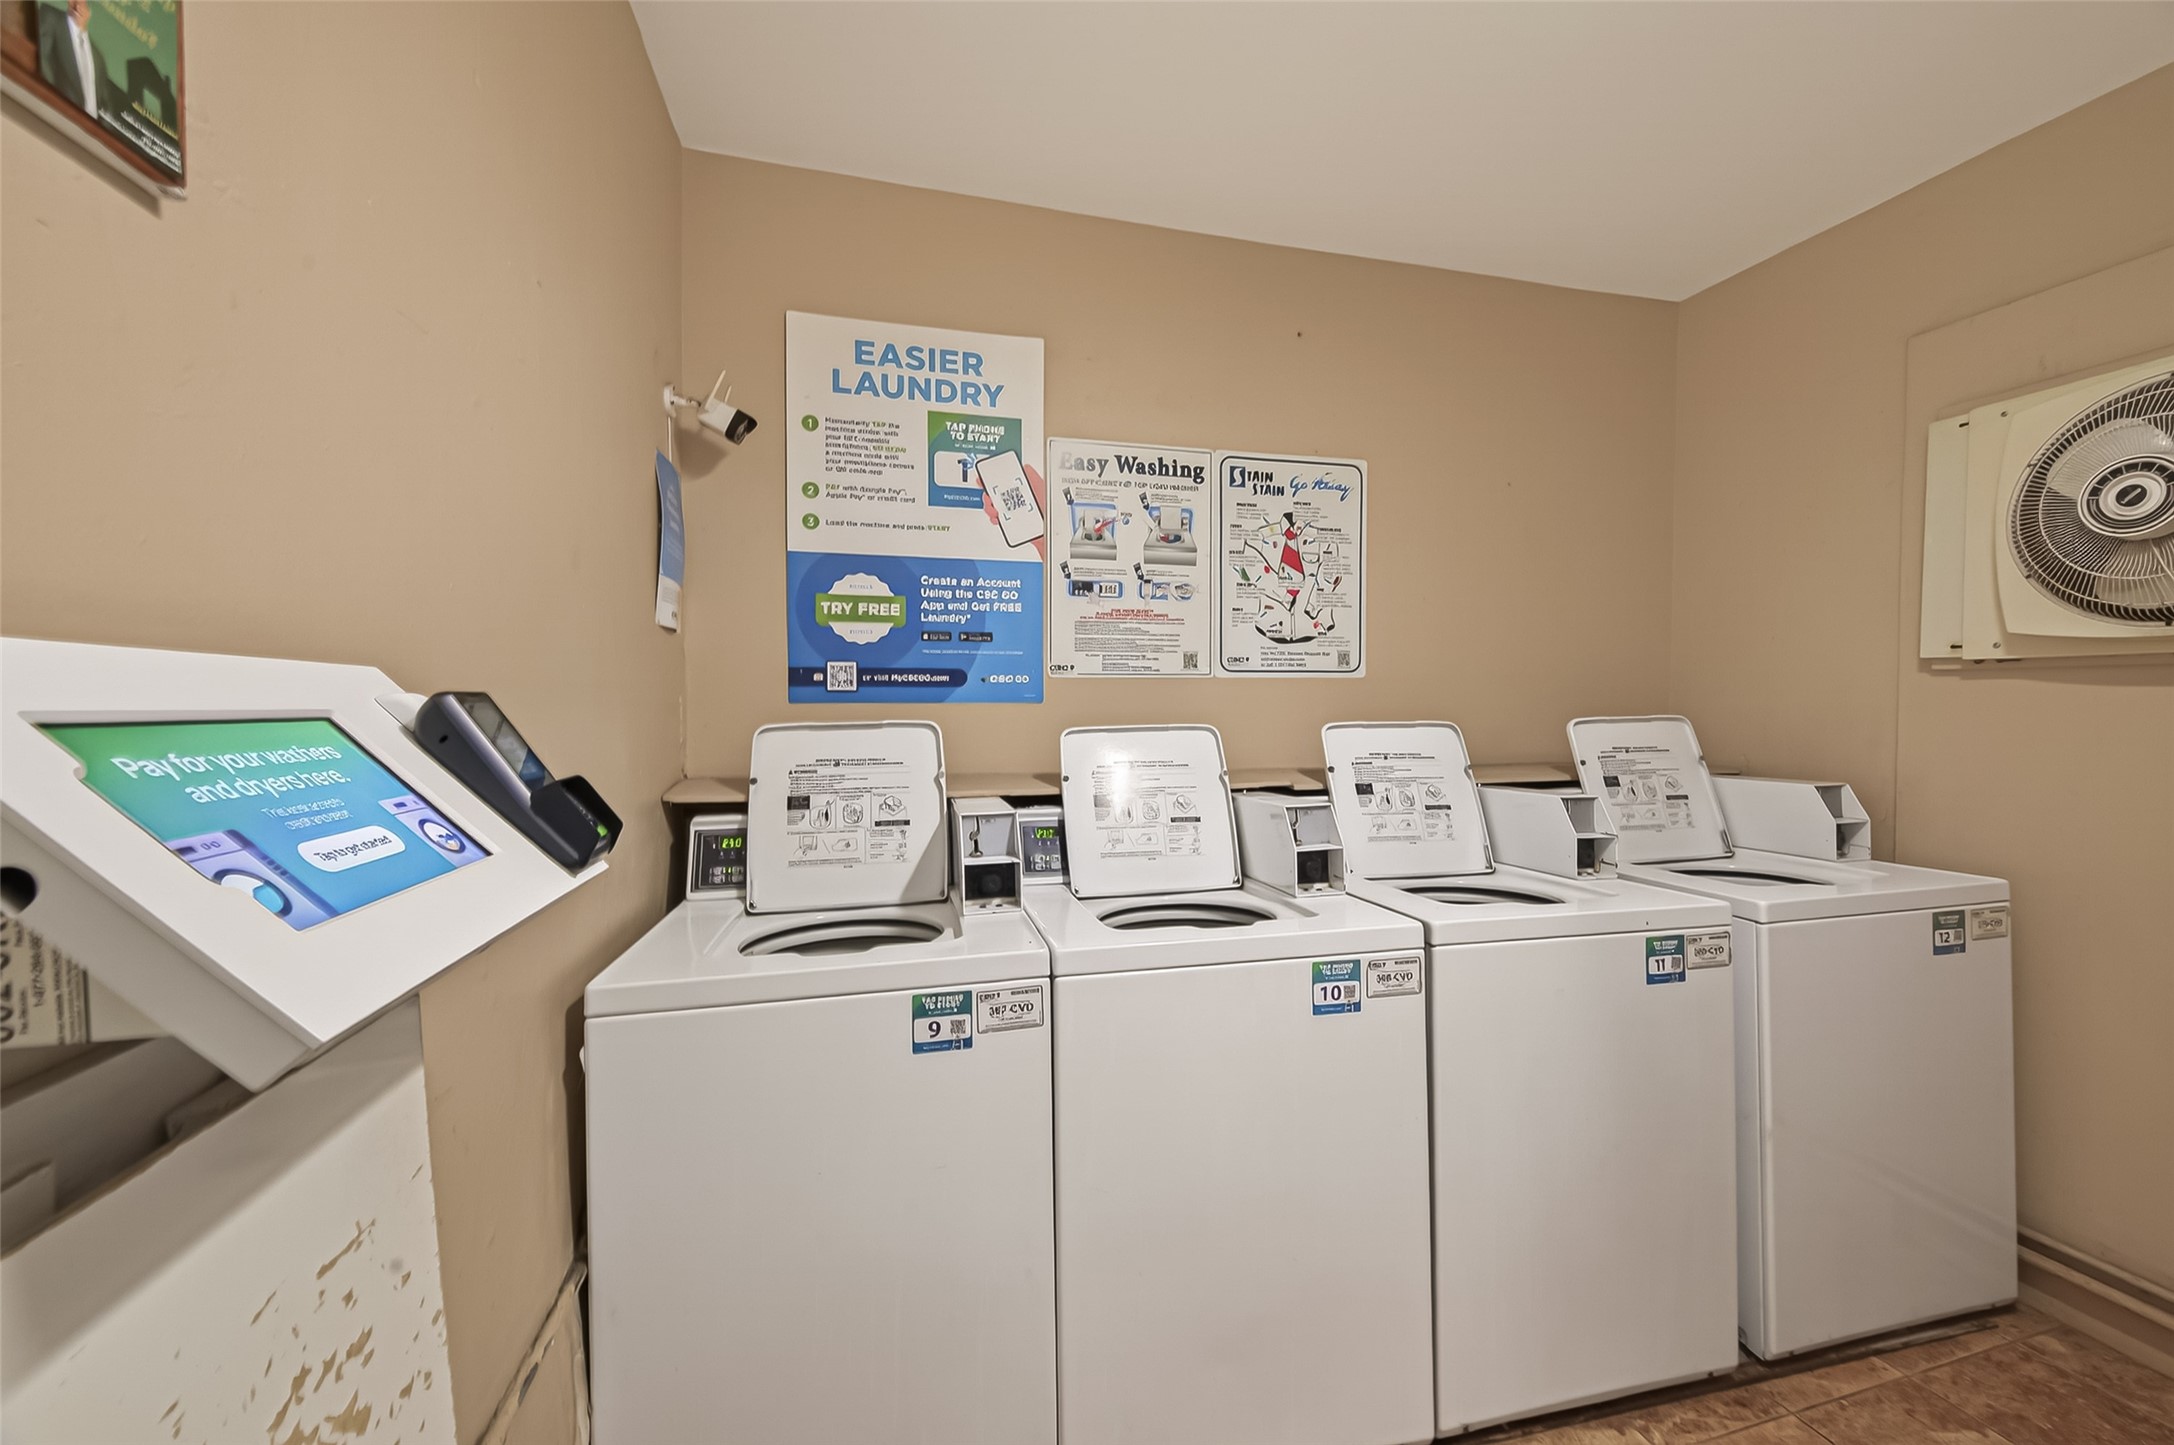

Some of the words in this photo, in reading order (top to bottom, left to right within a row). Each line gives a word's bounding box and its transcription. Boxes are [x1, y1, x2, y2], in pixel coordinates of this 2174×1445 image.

[854, 339, 984, 377] EASIER
[832, 367, 1005, 408] LAUNDRY
[945, 421, 966, 431] TAP
[950, 431, 965, 440] TO
[1059, 451, 1109, 478] Easy
[1114, 454, 1205, 485] Washing
[807, 485, 815, 496] 2
[1252, 483, 1285, 496] STAIN
[1290, 475, 1308, 497] Go
[806, 516, 815, 527] 3
[921, 575, 957, 586] Create
[961, 578, 974, 587] an
[977, 577, 1021, 588] Account
[921, 588, 952, 600] Using
[955, 589, 973, 599] the
[820, 601, 853, 615] TRY
[858, 602, 900, 616] FREE
[921, 600, 945, 611] App
[948, 602, 968, 611] and
[971, 602, 990, 612] Get
[993, 602, 1022, 613] FREE
[110, 755, 181, 781] Pay
[168, 752, 214, 774] for
[208, 751, 265, 775] your
[262, 745, 342, 765] washers
[184, 779, 240, 803] and
[233, 771, 303, 798] dryers
[295, 768, 351, 789] here.
[1939, 931, 1951, 943] 12
[1655, 958, 1665, 972] 11
[1320, 985, 1342, 1001] 10
[928, 1021, 941, 1039] 9
